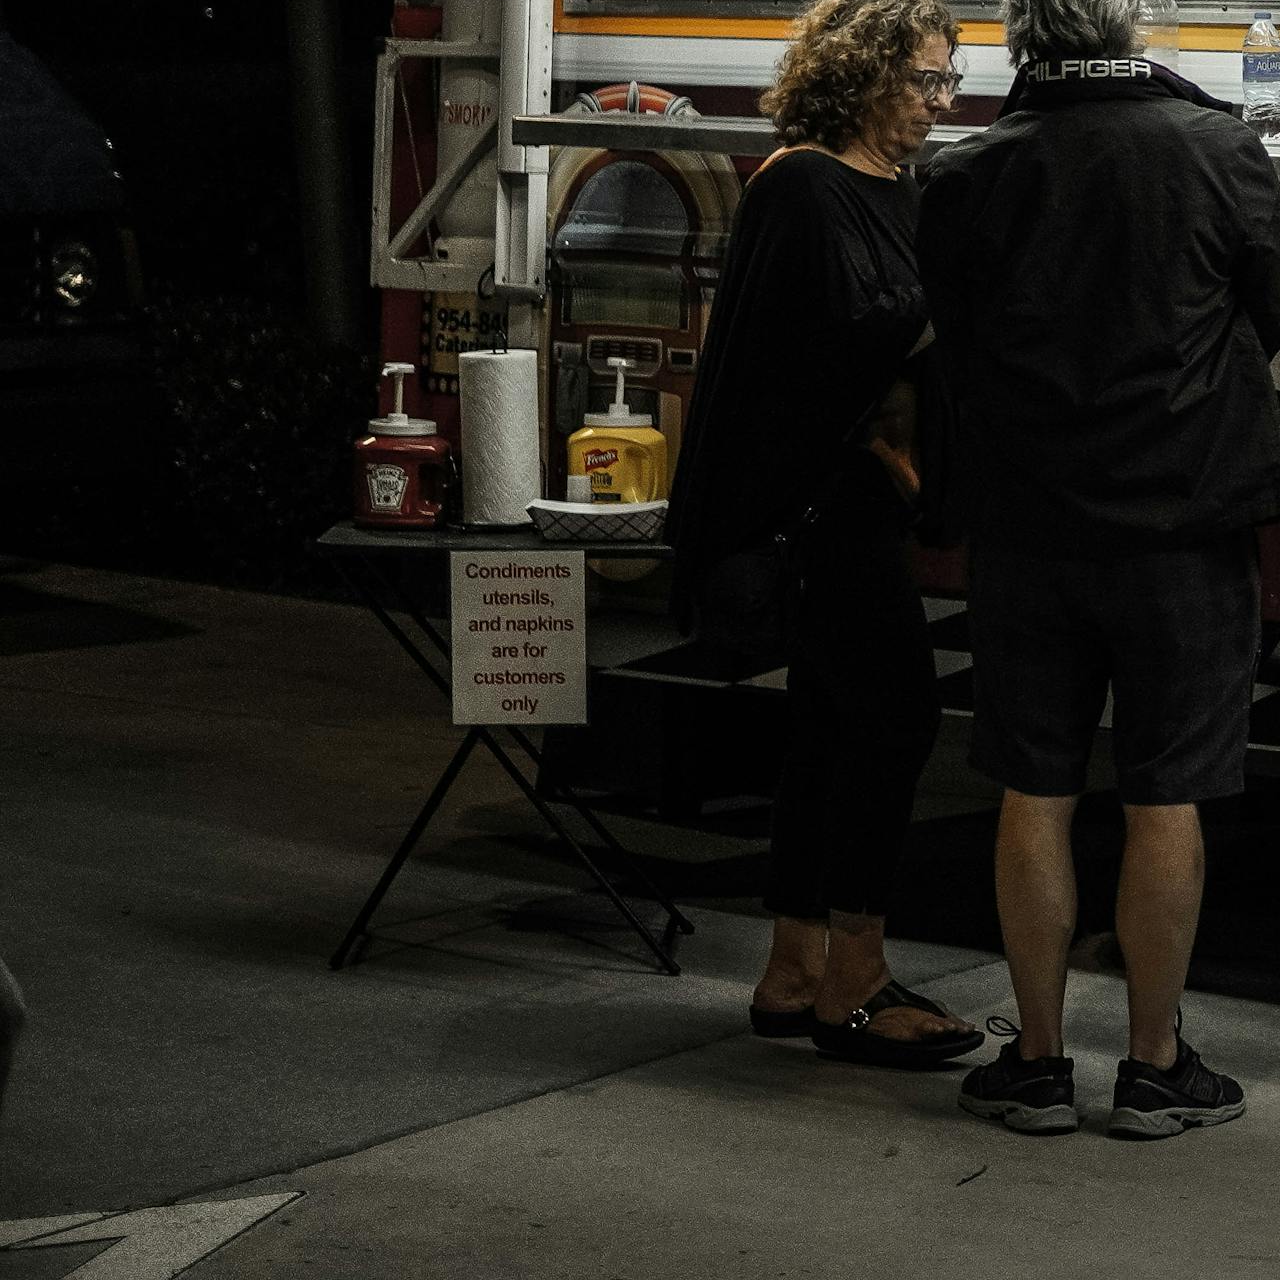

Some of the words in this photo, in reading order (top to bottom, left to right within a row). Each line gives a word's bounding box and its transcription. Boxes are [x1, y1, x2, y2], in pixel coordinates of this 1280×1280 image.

[1026, 59, 1152, 82] HILFIGER
[465, 562, 571, 580] Condiments
[483, 590, 555, 607] utensils,
[469, 616, 501, 632] and
[505, 616, 574, 633] napkins
[491, 644, 518, 658] are
[524, 642, 547, 658] for
[474, 670, 566, 686] customers
[501, 697, 538, 715] only
